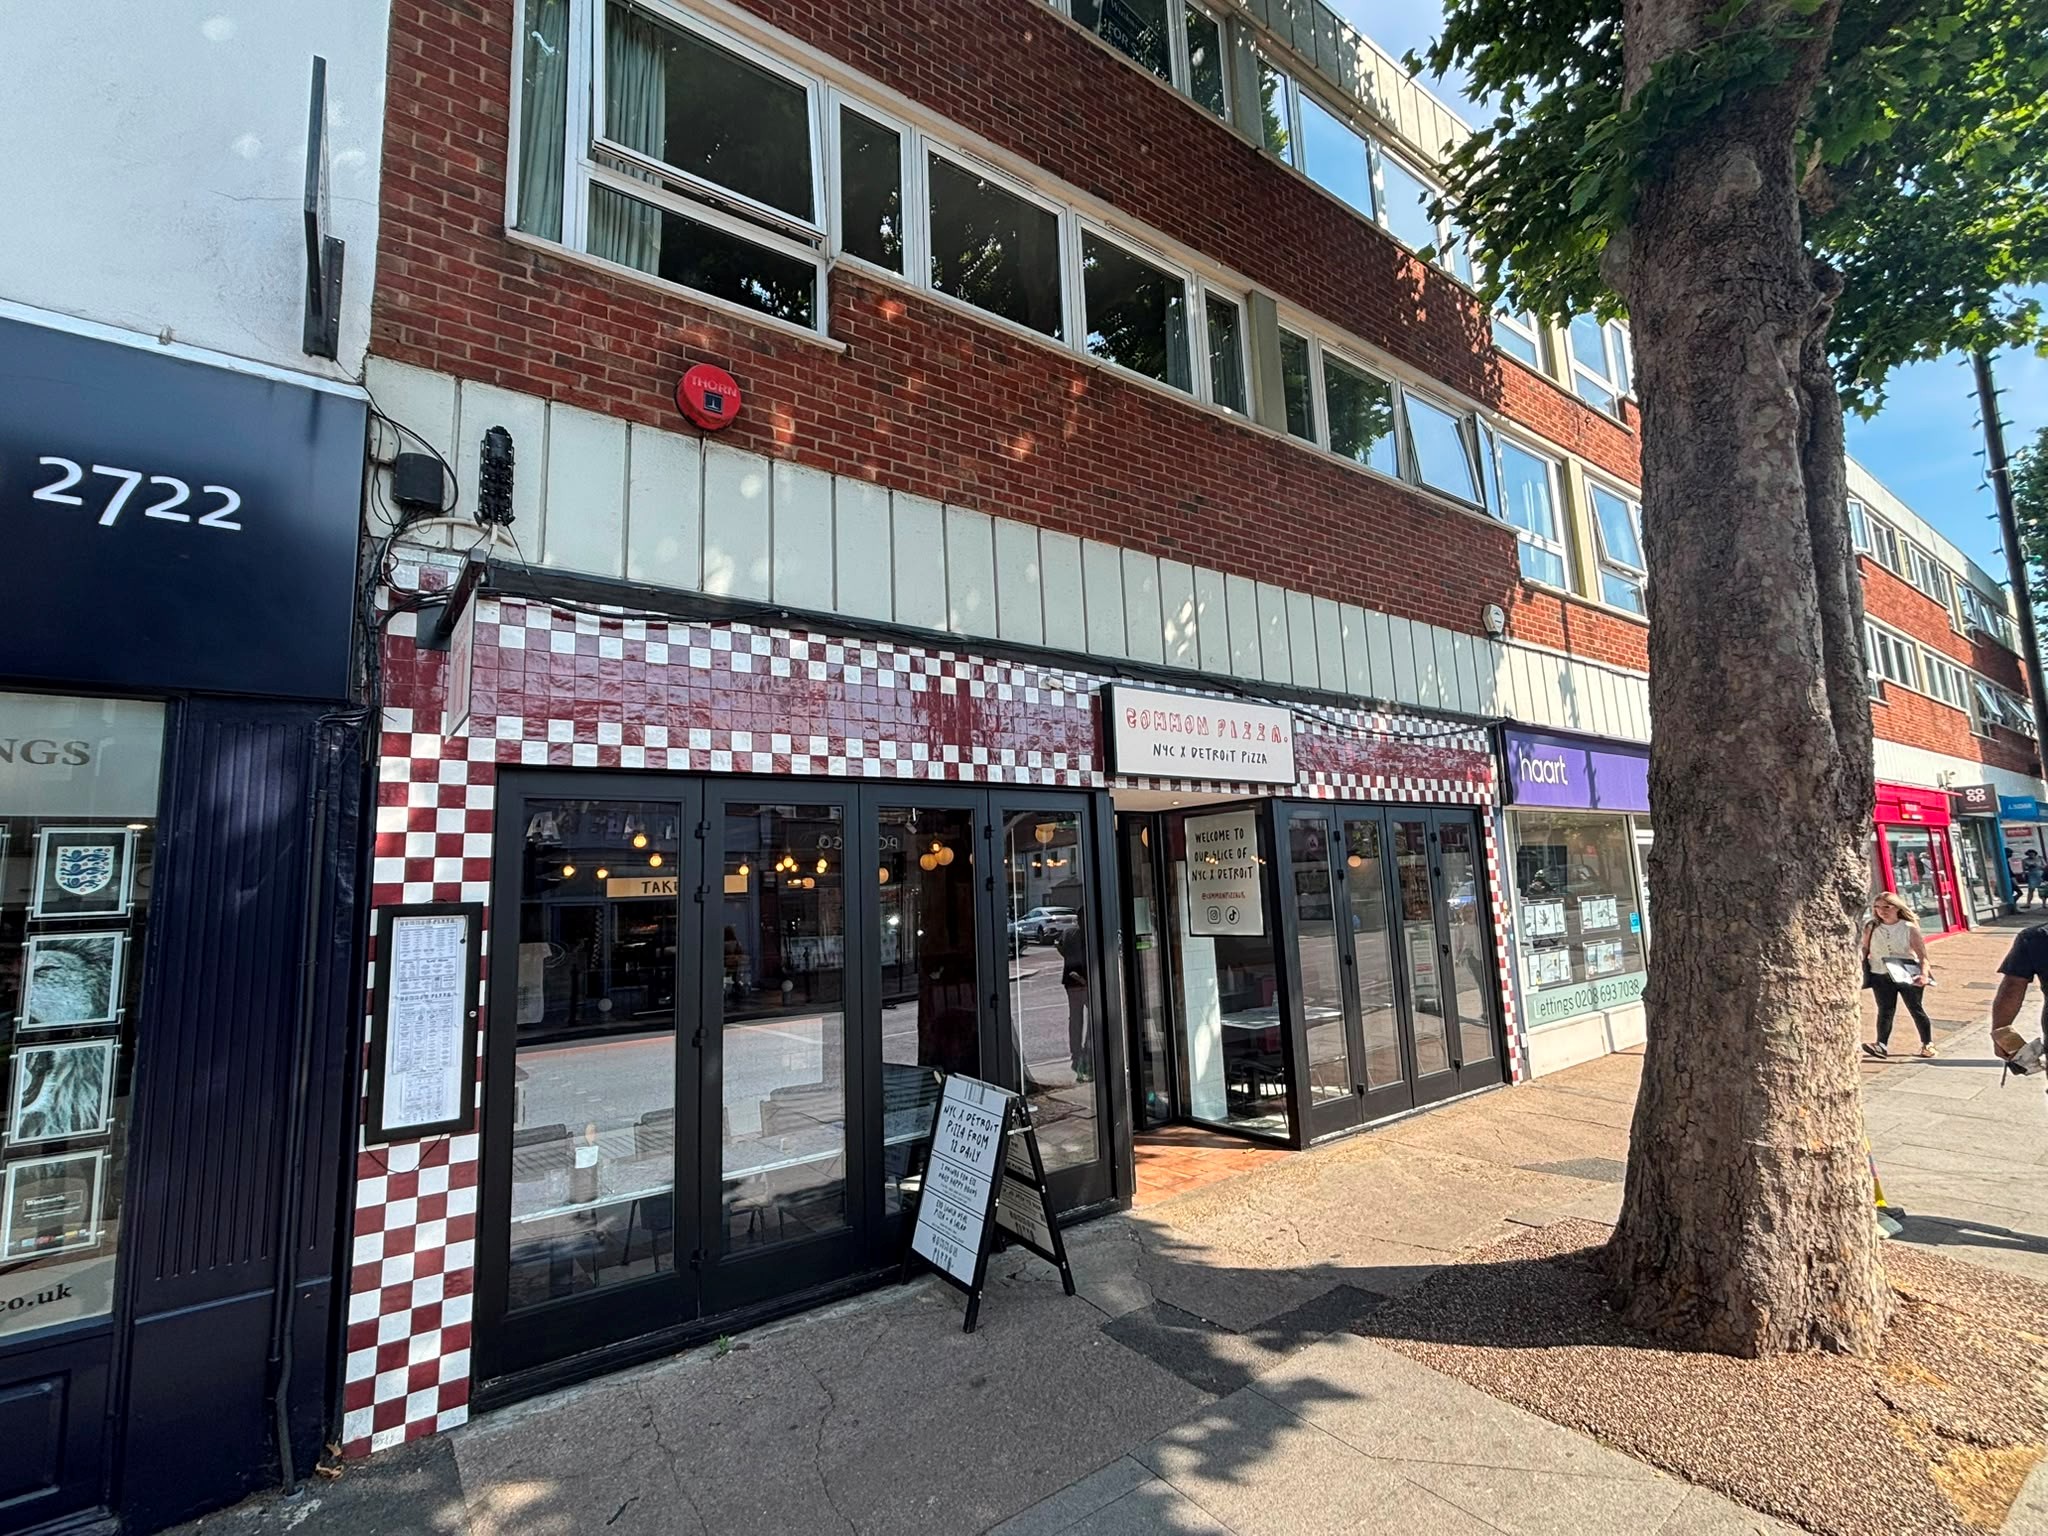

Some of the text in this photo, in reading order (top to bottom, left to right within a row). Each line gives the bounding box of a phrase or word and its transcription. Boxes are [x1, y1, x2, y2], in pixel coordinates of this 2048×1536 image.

[1108, 22, 1128, 47] FOR
[692, 376, 737, 397] THORN
[33, 457, 241, 530] 2722
[1126, 708, 1288, 743] COMMON PIZZA.
[1153, 744, 1175, 757] NYC
[1519, 747, 1568, 786] haart
[1195, 828, 1244, 842] WELCOME TO
[1194, 851, 1208, 862] OUR
[1237, 847, 1248, 859] OF
[1192, 870, 1206, 882] NYC
[1534, 979, 1640, 1018] Lettings 0208 693 7038
[944, 1104, 956, 1118] NYC
[950, 1139, 958, 1152] 12
[967, 1130, 989, 1150] FROM
